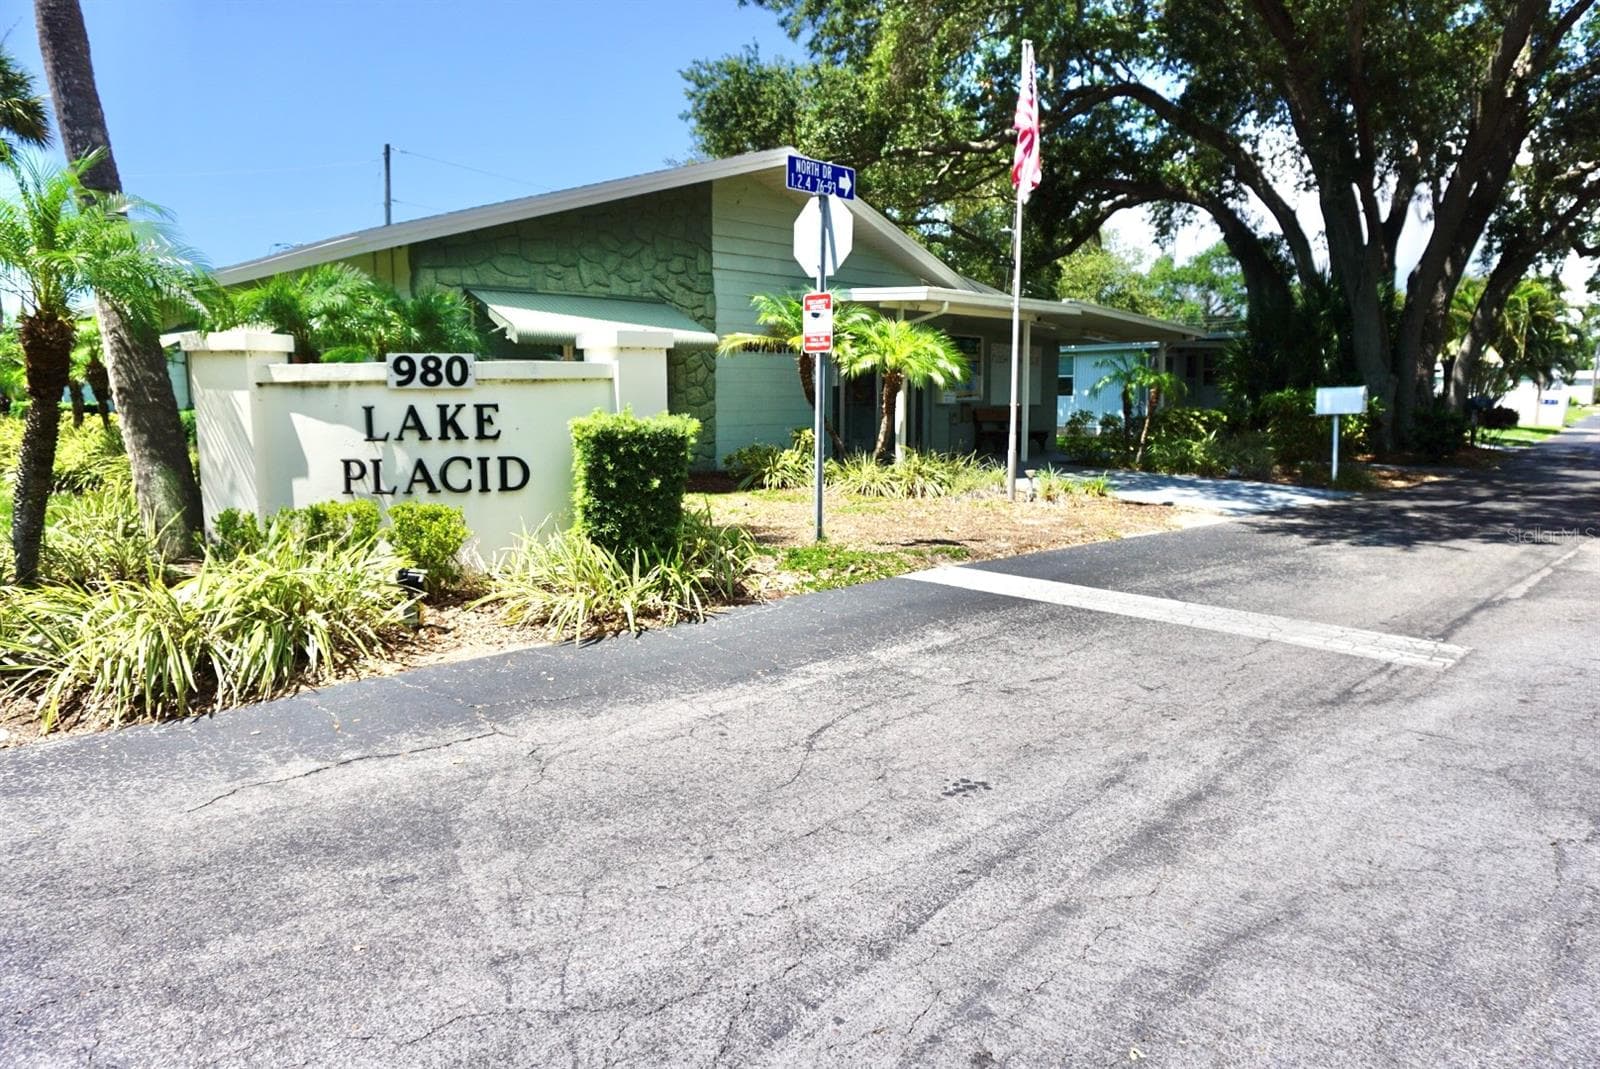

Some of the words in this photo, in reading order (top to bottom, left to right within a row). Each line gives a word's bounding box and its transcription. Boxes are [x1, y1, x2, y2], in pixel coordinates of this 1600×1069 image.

[795, 160, 820, 177] NORTH
[822, 165, 833, 180] DR
[392, 355, 469, 387] 980
[362, 403, 502, 442] LAKE
[340, 456, 531, 495] PLACID
